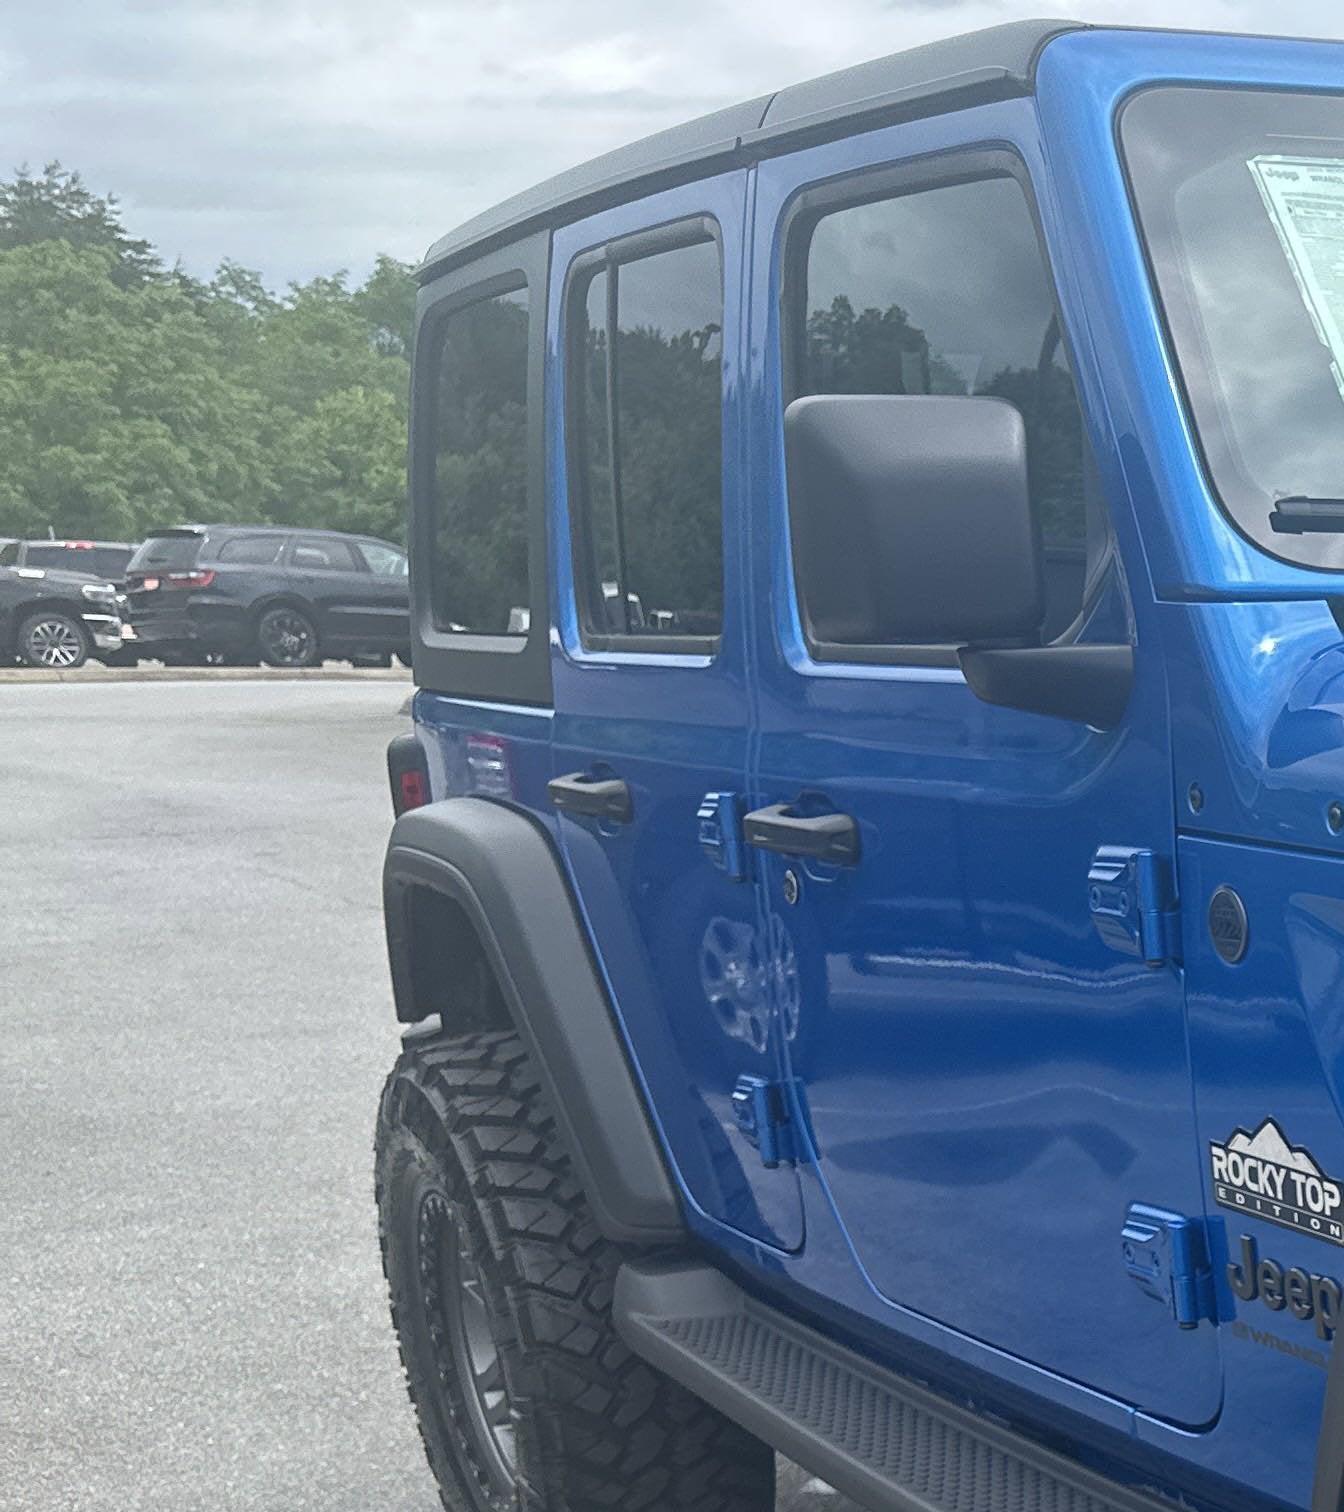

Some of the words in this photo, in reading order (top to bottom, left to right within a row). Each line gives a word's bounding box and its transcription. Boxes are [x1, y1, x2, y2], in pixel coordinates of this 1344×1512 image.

[1211, 1145, 1287, 1201] ROCKY
[1290, 1171, 1342, 1217] TOP
[1218, 1189, 1341, 1238] EDITION
[1227, 1234, 1342, 1341] Jeep
